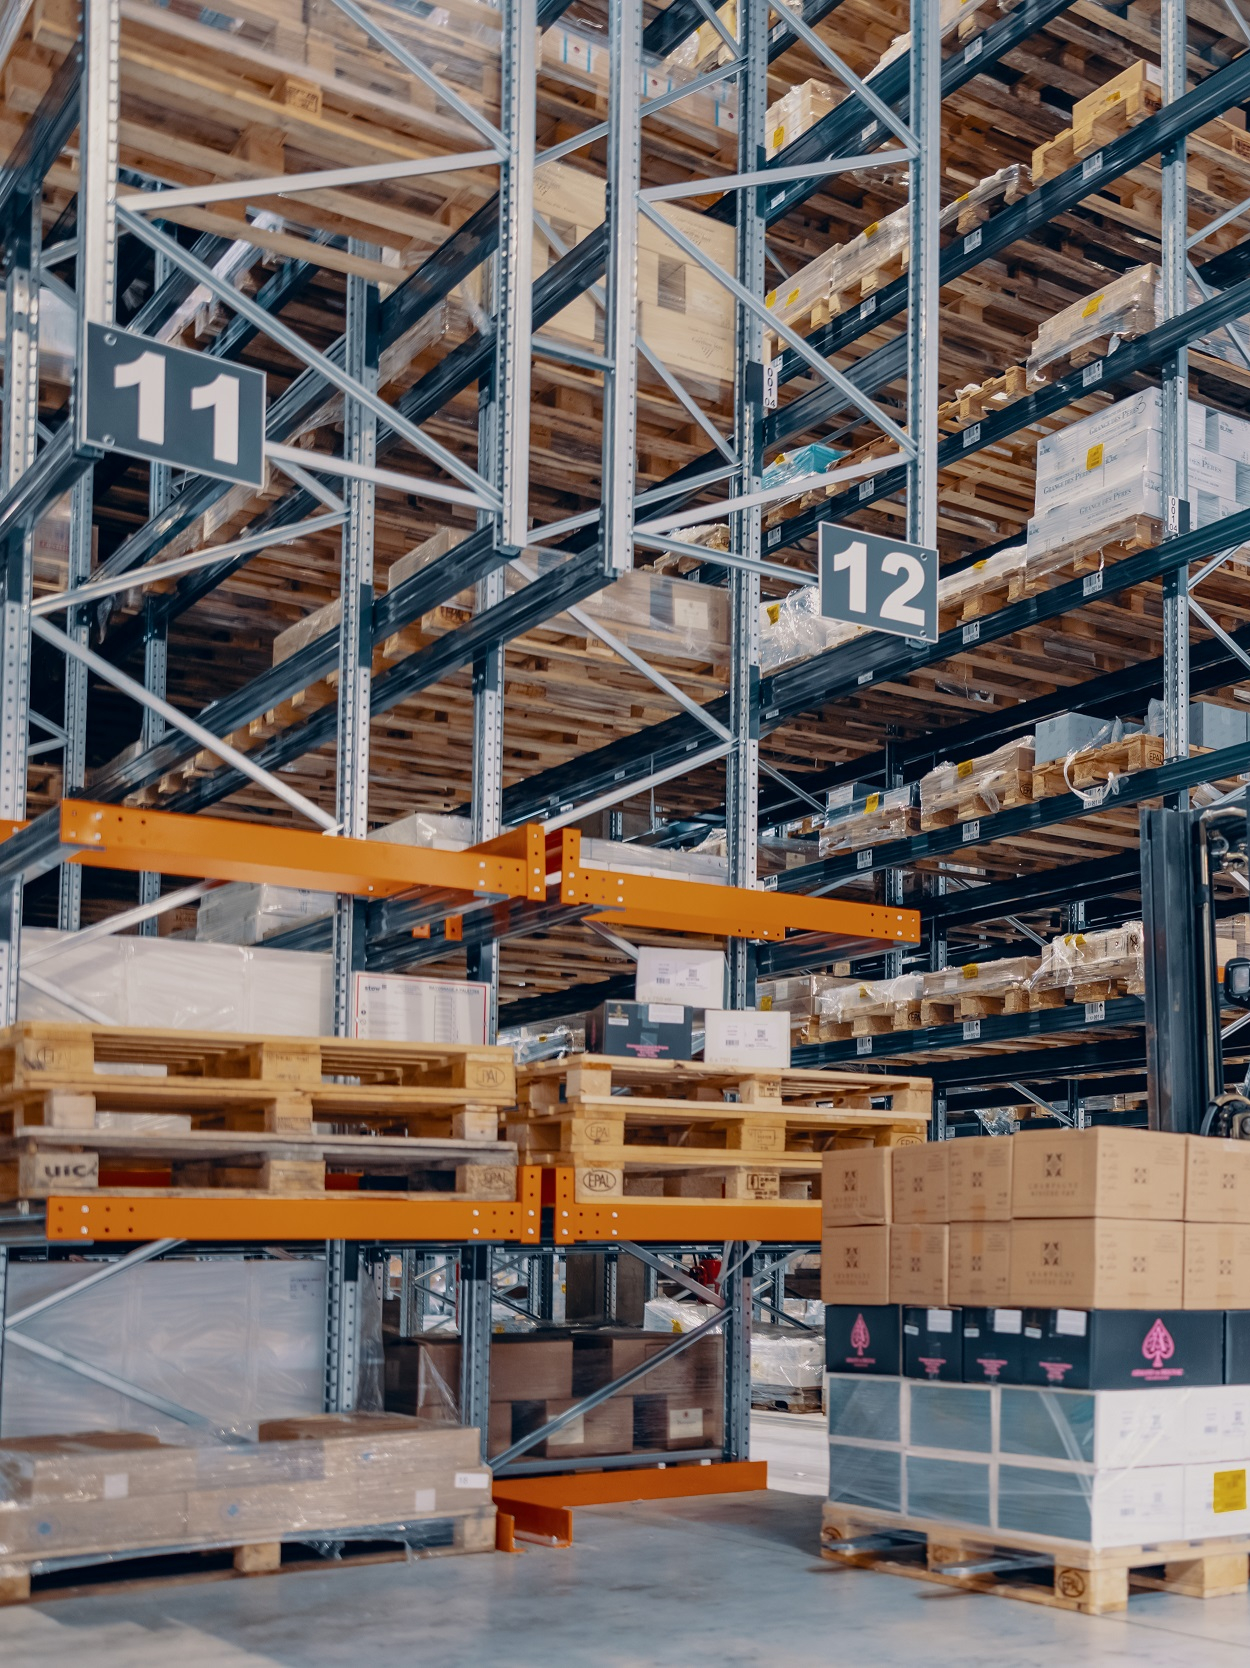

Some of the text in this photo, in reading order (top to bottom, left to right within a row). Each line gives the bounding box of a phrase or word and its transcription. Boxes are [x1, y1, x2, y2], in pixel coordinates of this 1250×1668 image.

[114, 350, 240, 466] 11
[833, 541, 926, 627] 12
[588, 1175, 609, 1188] EPAL
